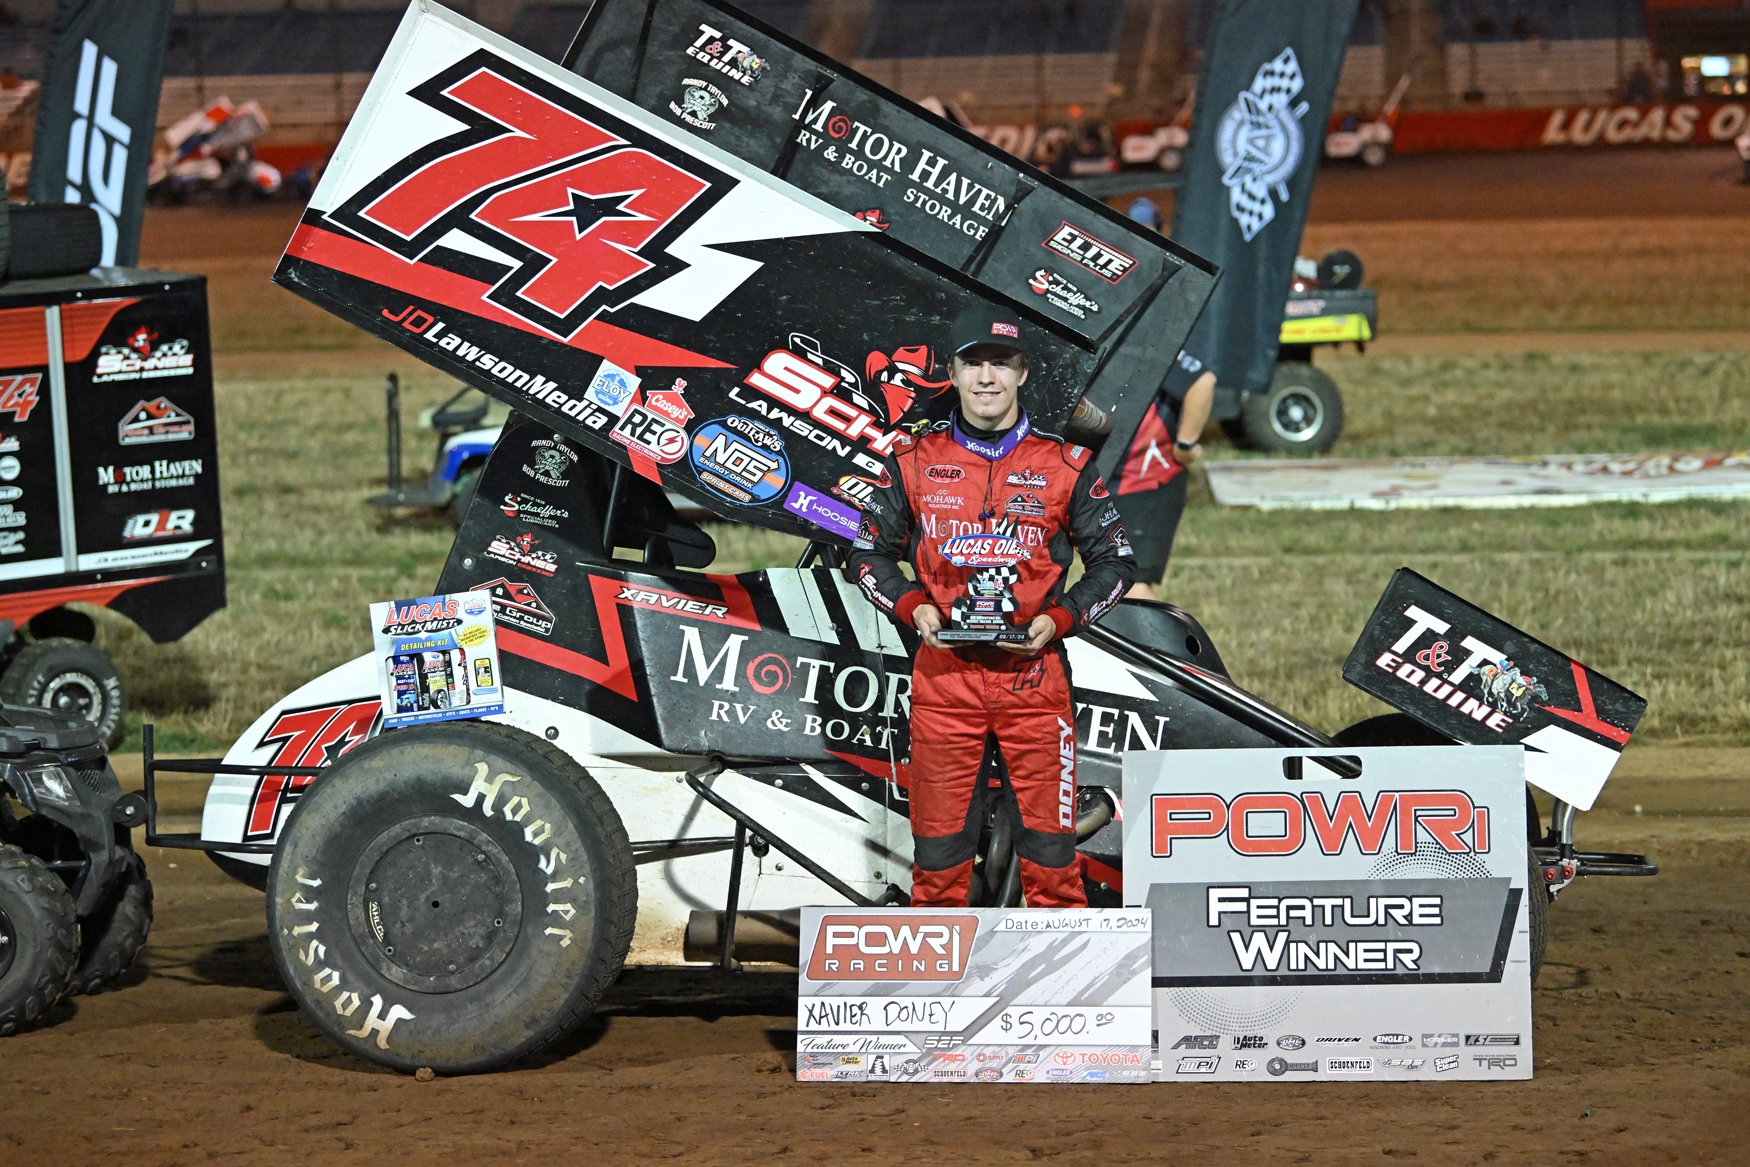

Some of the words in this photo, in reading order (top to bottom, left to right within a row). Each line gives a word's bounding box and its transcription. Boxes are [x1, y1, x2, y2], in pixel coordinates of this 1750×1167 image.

[685, 46, 755, 86] EQUINE
[681, 77, 709, 88] RANDY
[706, 81, 729, 107] TAYLOR
[669, 101, 683, 118] BOB
[680, 110, 716, 131] PRESCOTT
[1540, 96, 1701, 146] LUCAS
[791, 88, 909, 172] MOTOR
[907, 149, 1012, 226] HAVEN
[345, 60, 722, 328] 74
[796, 130, 823, 151] RV
[823, 145, 838, 161] &
[841, 153, 891, 188] BOAT
[903, 187, 989, 241] STORAGE
[1048, 240, 1082, 261] SIGNS
[1082, 259, 1113, 278] PLUS
[1052, 225, 1132, 275] ELITE
[1028, 269, 1099, 312] Schaeffer's
[95, 353, 194, 374] SCHNEE
[592, 375, 632, 403] ELOY
[651, 394, 688, 420] Casey's
[727, 386, 852, 458] LAWSON
[530, 439, 555, 448] RANDY
[556, 443, 578, 463] TAYLOR
[612, 432, 631, 445] RACING
[630, 440, 662, 461] ELECTRONICS
[701, 432, 780, 485] NOS
[153, 458, 202, 479] HAVEN
[522, 464, 535, 478] BOB
[534, 473, 570, 487] PRESCOTT
[698, 457, 730, 477] ENERGY
[729, 471, 755, 489] DRINK
[928, 467, 962, 478] ENGLER
[701, 472, 728, 490] SPRINT
[728, 485, 750, 501] CARS
[922, 494, 965, 505] MOHAWK
[500, 492, 569, 518] Schaeffer's
[812, 502, 860, 531] HOOSIE
[487, 540, 559, 573] SCHNEE
[943, 538, 993, 554] LUCAS
[993, 538, 1017, 555] OIL
[968, 554, 1018, 566] Speedway
[385, 600, 460, 626] LUCAS
[617, 586, 729, 619] XAVIER
[505, 606, 552, 629] Group
[400, 640, 435, 651] DETAILING
[437, 638, 449, 646] KIT
[670, 624, 912, 720] MOTOR
[1012, 655, 1046, 692] 74
[1375, 651, 1515, 734] EQUINE
[708, 699, 757, 725] RV
[765, 708, 792, 732] &
[802, 714, 899, 751] BOAT
[1057, 716, 1075, 829] DONEY
[450, 760, 587, 948] Hoosier
[1207, 886, 1444, 928] FEATURE
[1005, 917, 1045, 931] Date:
[1045, 917, 1092, 930] AUGUST
[282, 866, 417, 1050] Hoosier
[1228, 929, 1423, 972] WINNER
[825, 959, 950, 972] RACING
[804, 1000, 872, 1029] XAVIER
[883, 999, 956, 1031] DONEY
[800, 1036, 850, 1051] Feature
[852, 1036, 907, 1052] Winner
[1240, 1041, 1269, 1049] Meter
[1241, 1034, 1264, 1042] Auto
[1376, 1035, 1410, 1043] ENGLER
[1079, 1052, 1141, 1065] TOYOTA
[1329, 1059, 1371, 1070] SCHOENFELD
[1435, 1054, 1459, 1065] Super
[1435, 1061, 1459, 1073] Clean
[1472, 1058, 1518, 1071] TRD
[810, 1071, 830, 1079] FUEL
[933, 1070, 967, 1078] SCHOENFELD
